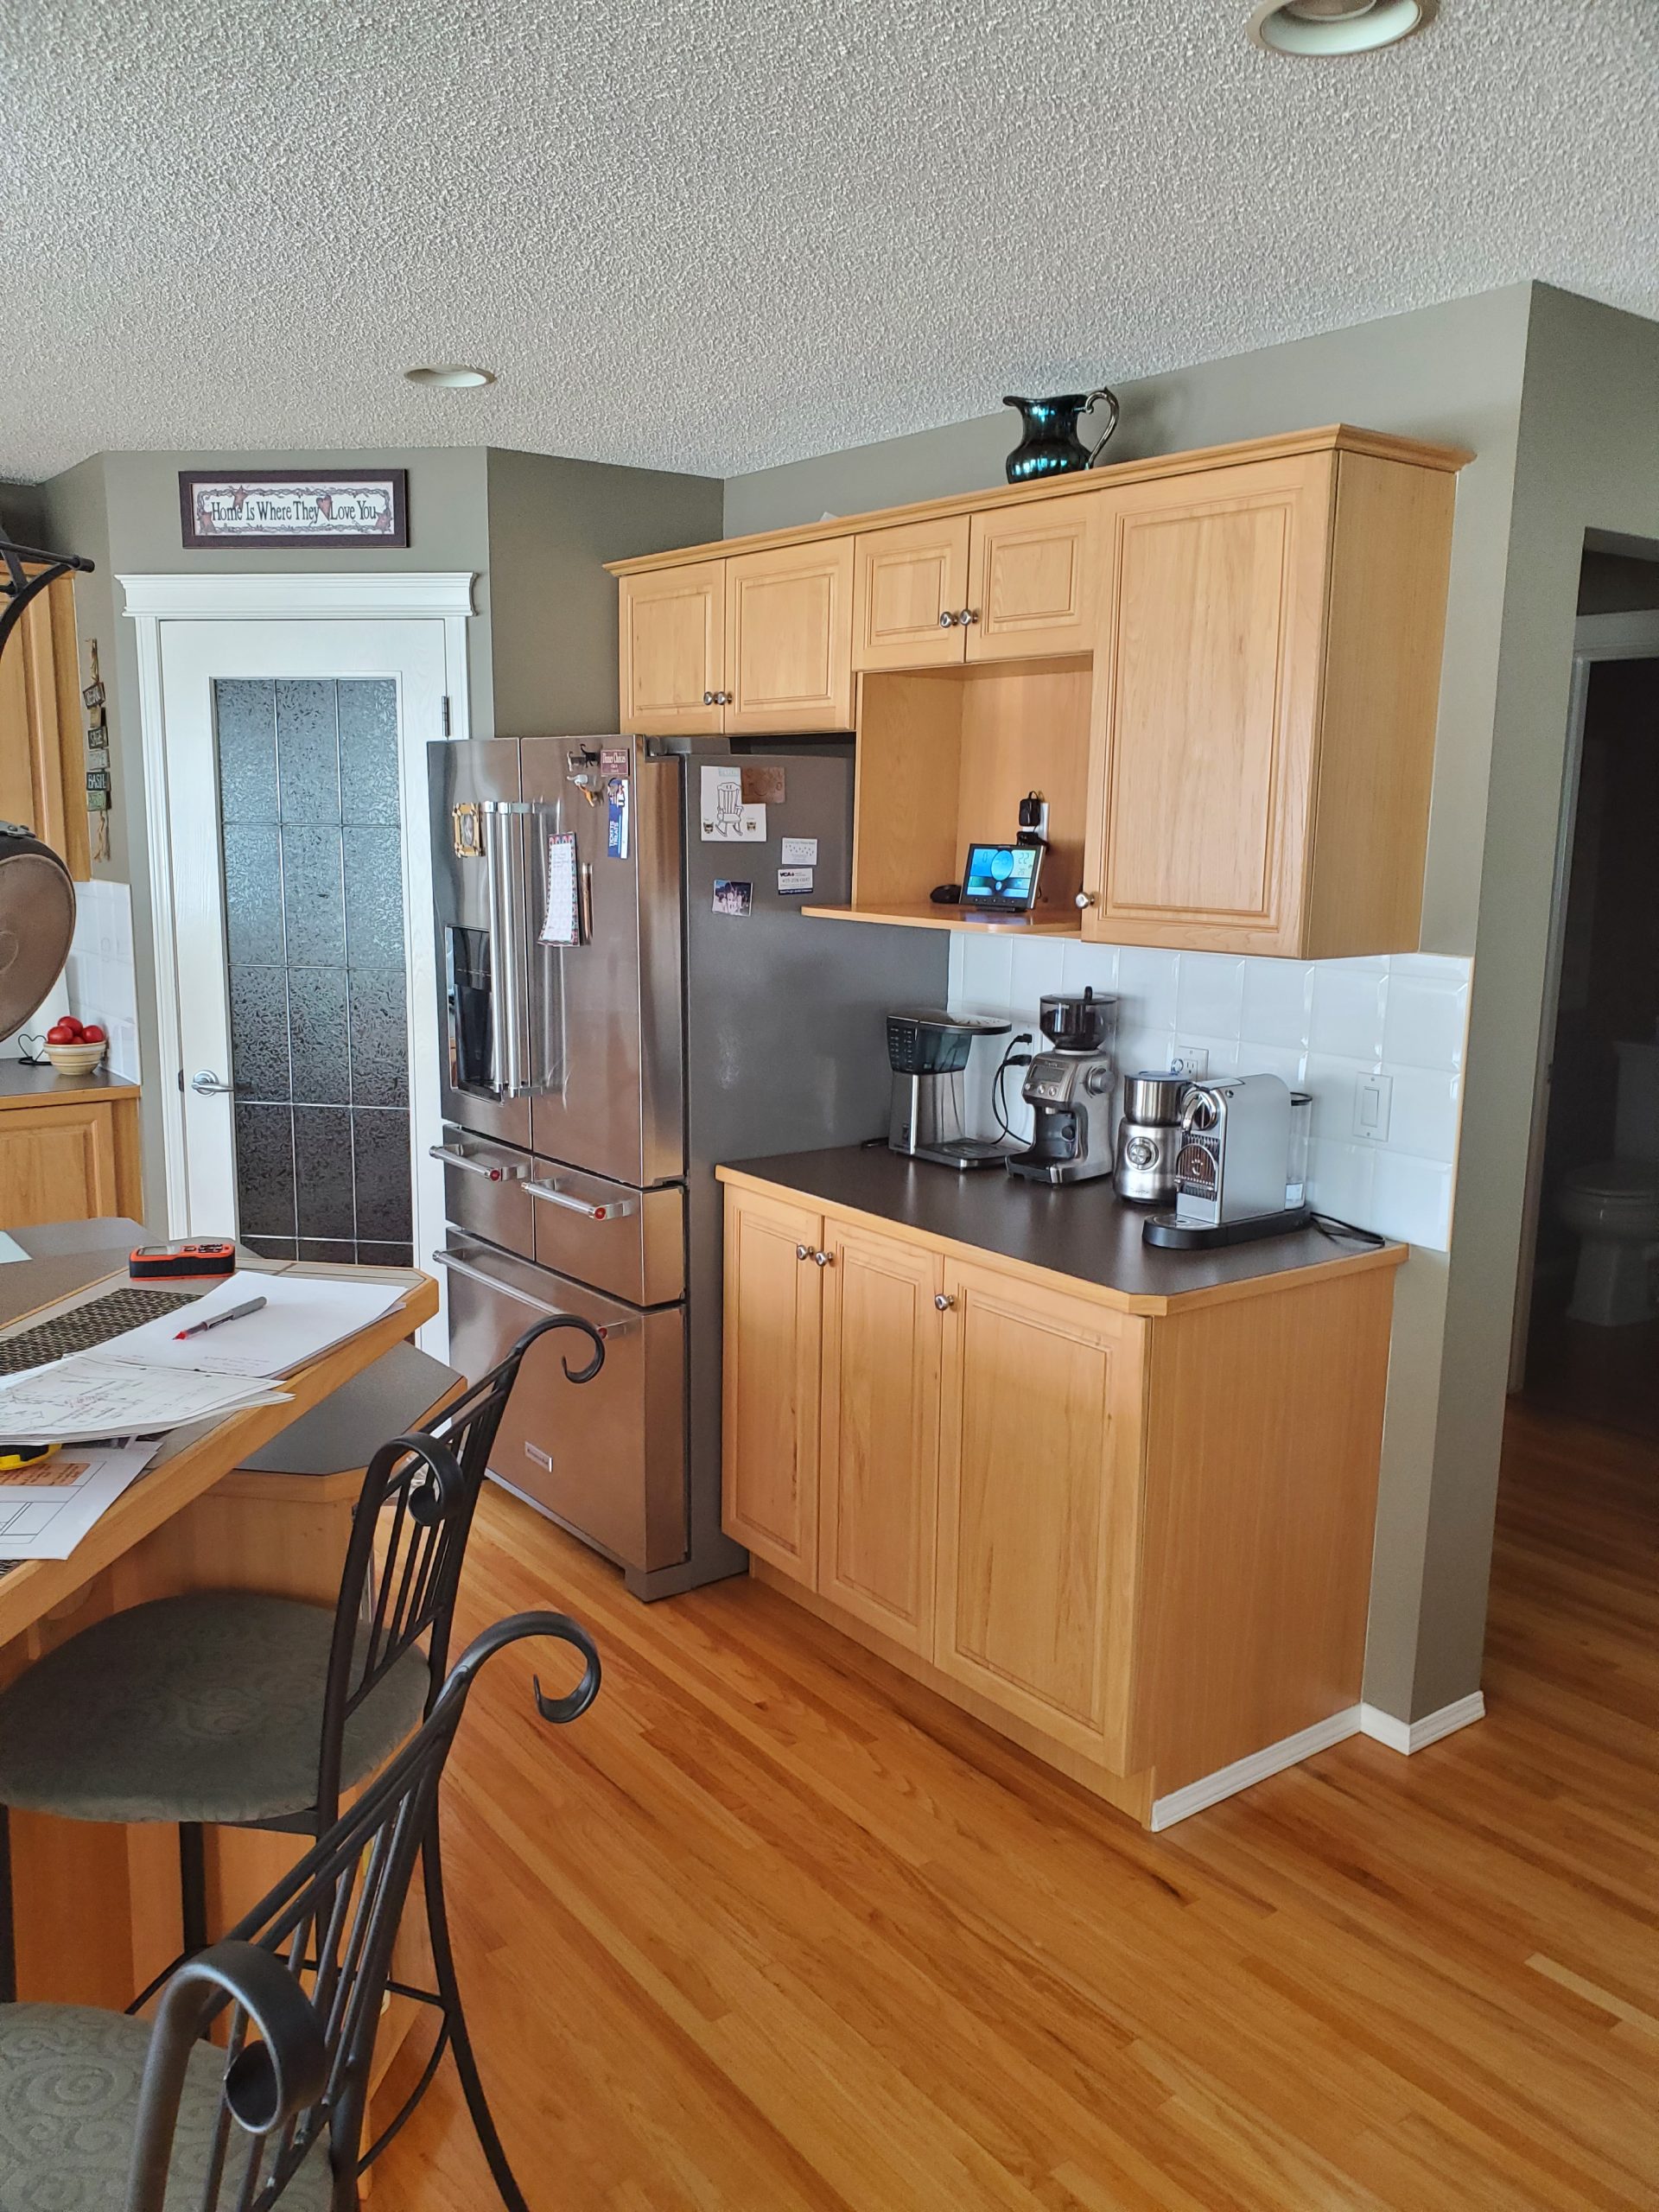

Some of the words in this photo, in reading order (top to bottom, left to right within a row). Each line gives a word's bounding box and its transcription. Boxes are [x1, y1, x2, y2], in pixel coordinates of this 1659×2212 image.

[211, 501, 243, 521] Home
[245, 501, 255, 520] Is
[257, 501, 292, 520] Where
[293, 501, 320, 524] They
[330, 502, 355, 520] Love
[357, 500, 377, 519] You
[88, 773, 106, 789] BASIL
[1018, 852, 1029, 864] 22
